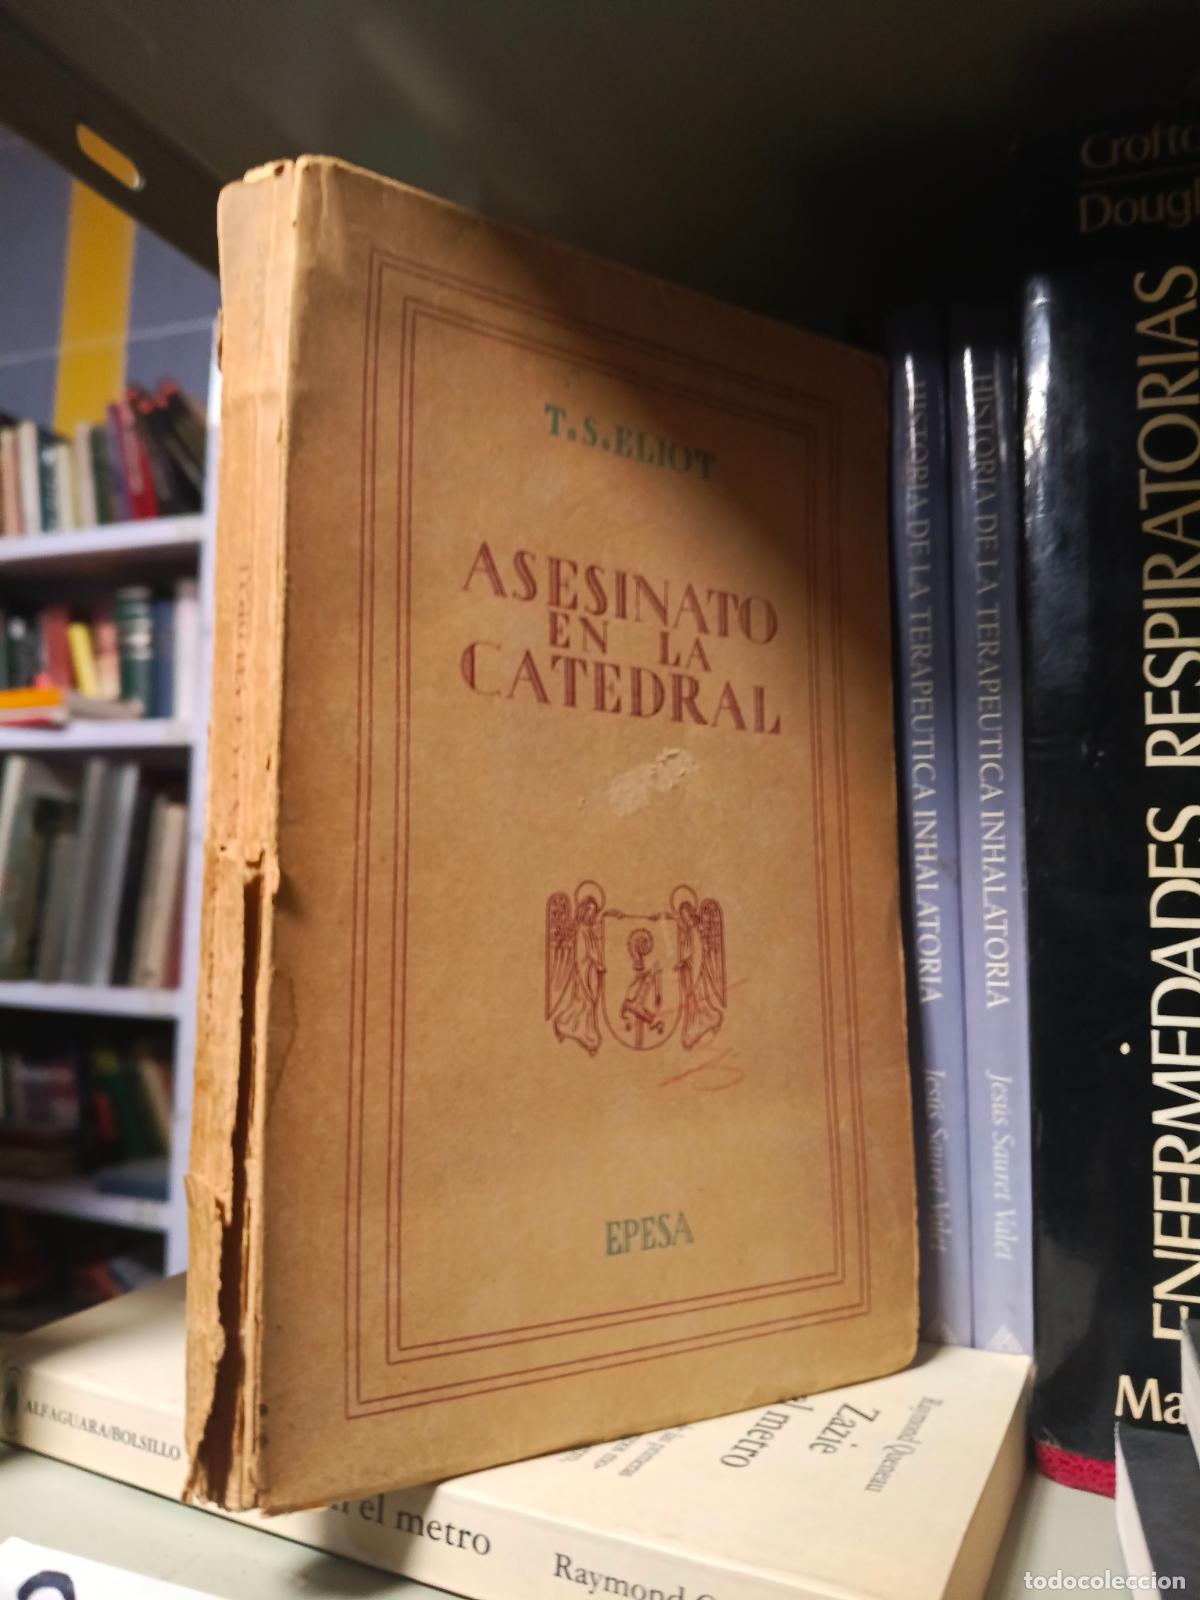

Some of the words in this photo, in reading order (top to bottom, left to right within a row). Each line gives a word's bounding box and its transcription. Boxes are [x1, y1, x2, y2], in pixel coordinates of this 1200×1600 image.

[908, 381, 929, 512] HISTORIA
[972, 373, 996, 504] HISTORIA
[909, 520, 931, 557] DE
[976, 514, 998, 549] DE
[1134, 265, 1200, 767] RESPIRATORIAS
[463, 540, 779, 645] ASESINATO
[909, 564, 931, 599] LA
[976, 559, 998, 595] LA
[548, 610, 609, 654] EN
[660, 631, 712, 672] LA
[460, 641, 782, 734] CATEDRAL
[913, 810, 943, 1003] INHALATORIA
[980, 810, 1010, 1008] INHALATORIA
[1146, 804, 1200, 1340] ENFERMEDADES
[992, 1131, 1015, 1200] Sauret
[605, 1211, 694, 1256] EPESA
[994, 1209, 1018, 1260] Valet
[26, 1400, 181, 1461] ALFAGUARA/BOLSILLO
[719, 1410, 789, 1468] metro
[809, 1402, 880, 1454] Zazie
[360, 1494, 384, 1525] el
[395, 1508, 491, 1556] metro
